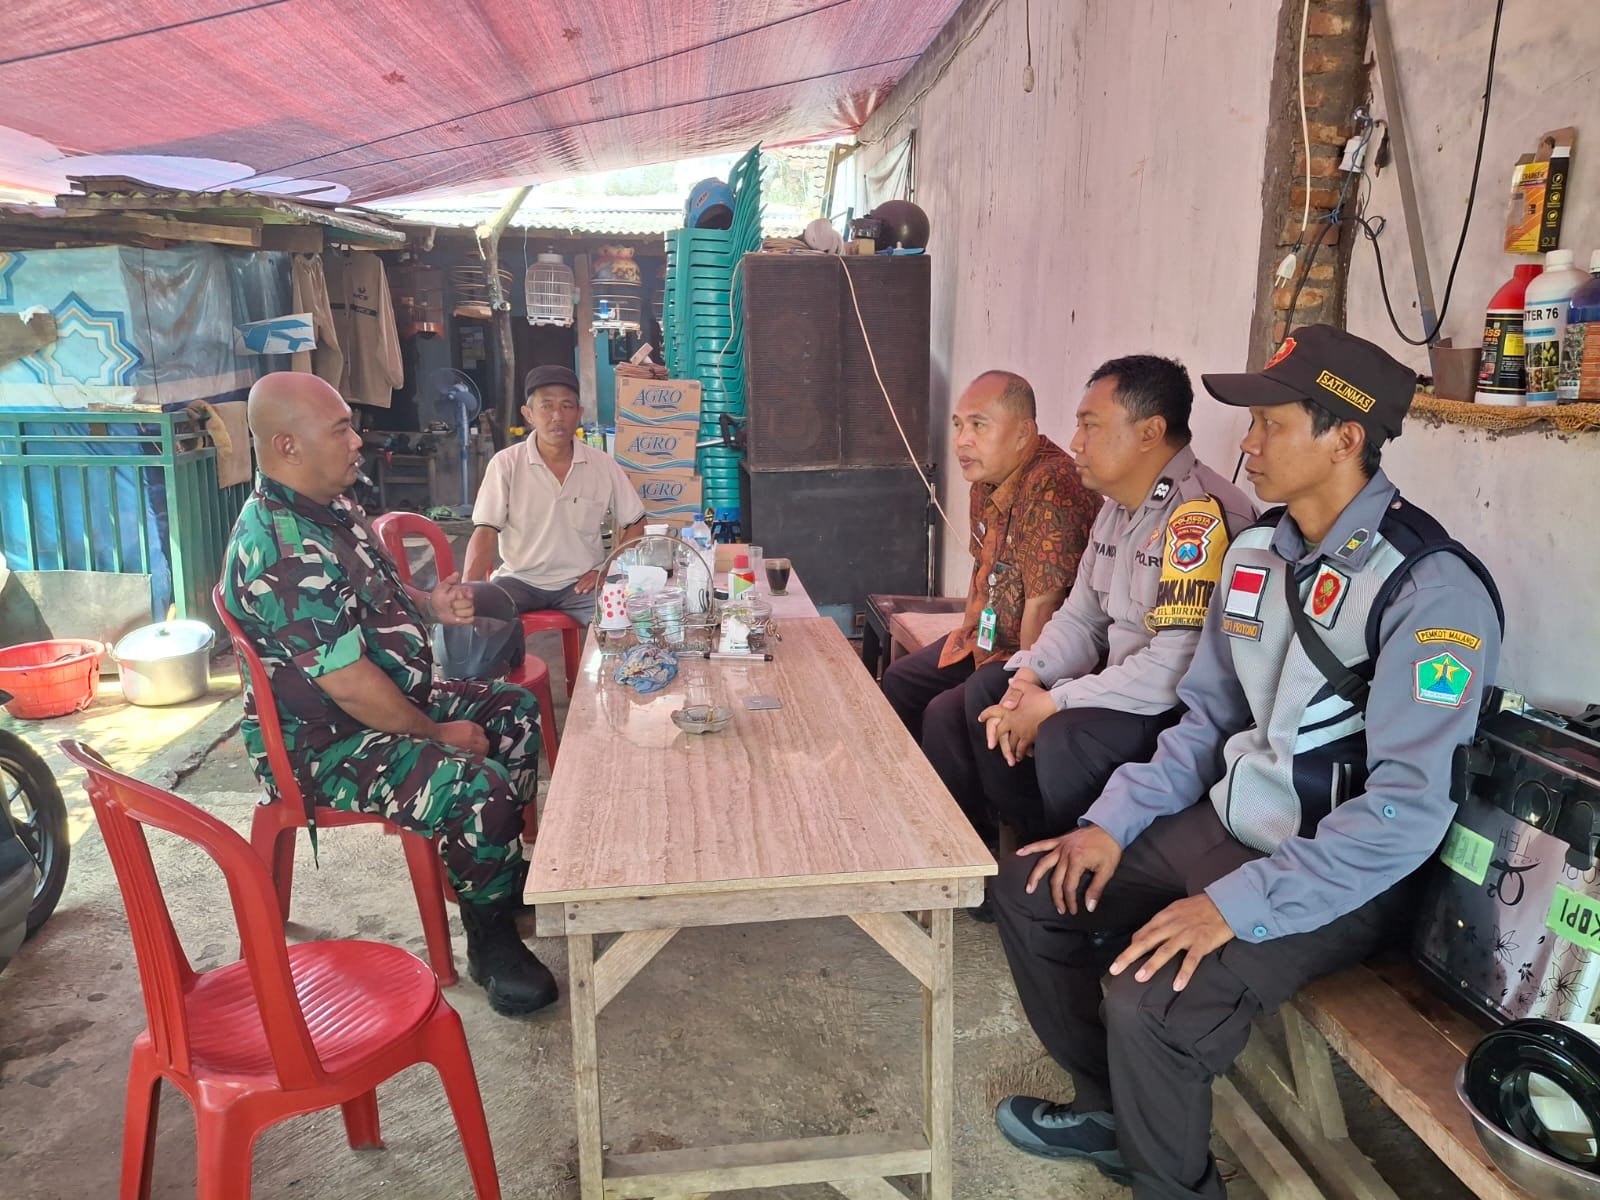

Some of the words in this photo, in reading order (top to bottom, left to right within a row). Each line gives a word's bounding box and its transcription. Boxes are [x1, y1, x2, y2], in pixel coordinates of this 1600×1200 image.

[1546, 307, 1559, 319] 76
[632, 388, 683, 406] AGRO
[1321, 375, 1371, 408] SATLINMAS
[627, 435, 679, 453] AGRO
[640, 483, 684, 499] AGRO
[1421, 630, 1446, 638] PEMKOT
[1449, 631, 1476, 645] MALANG
